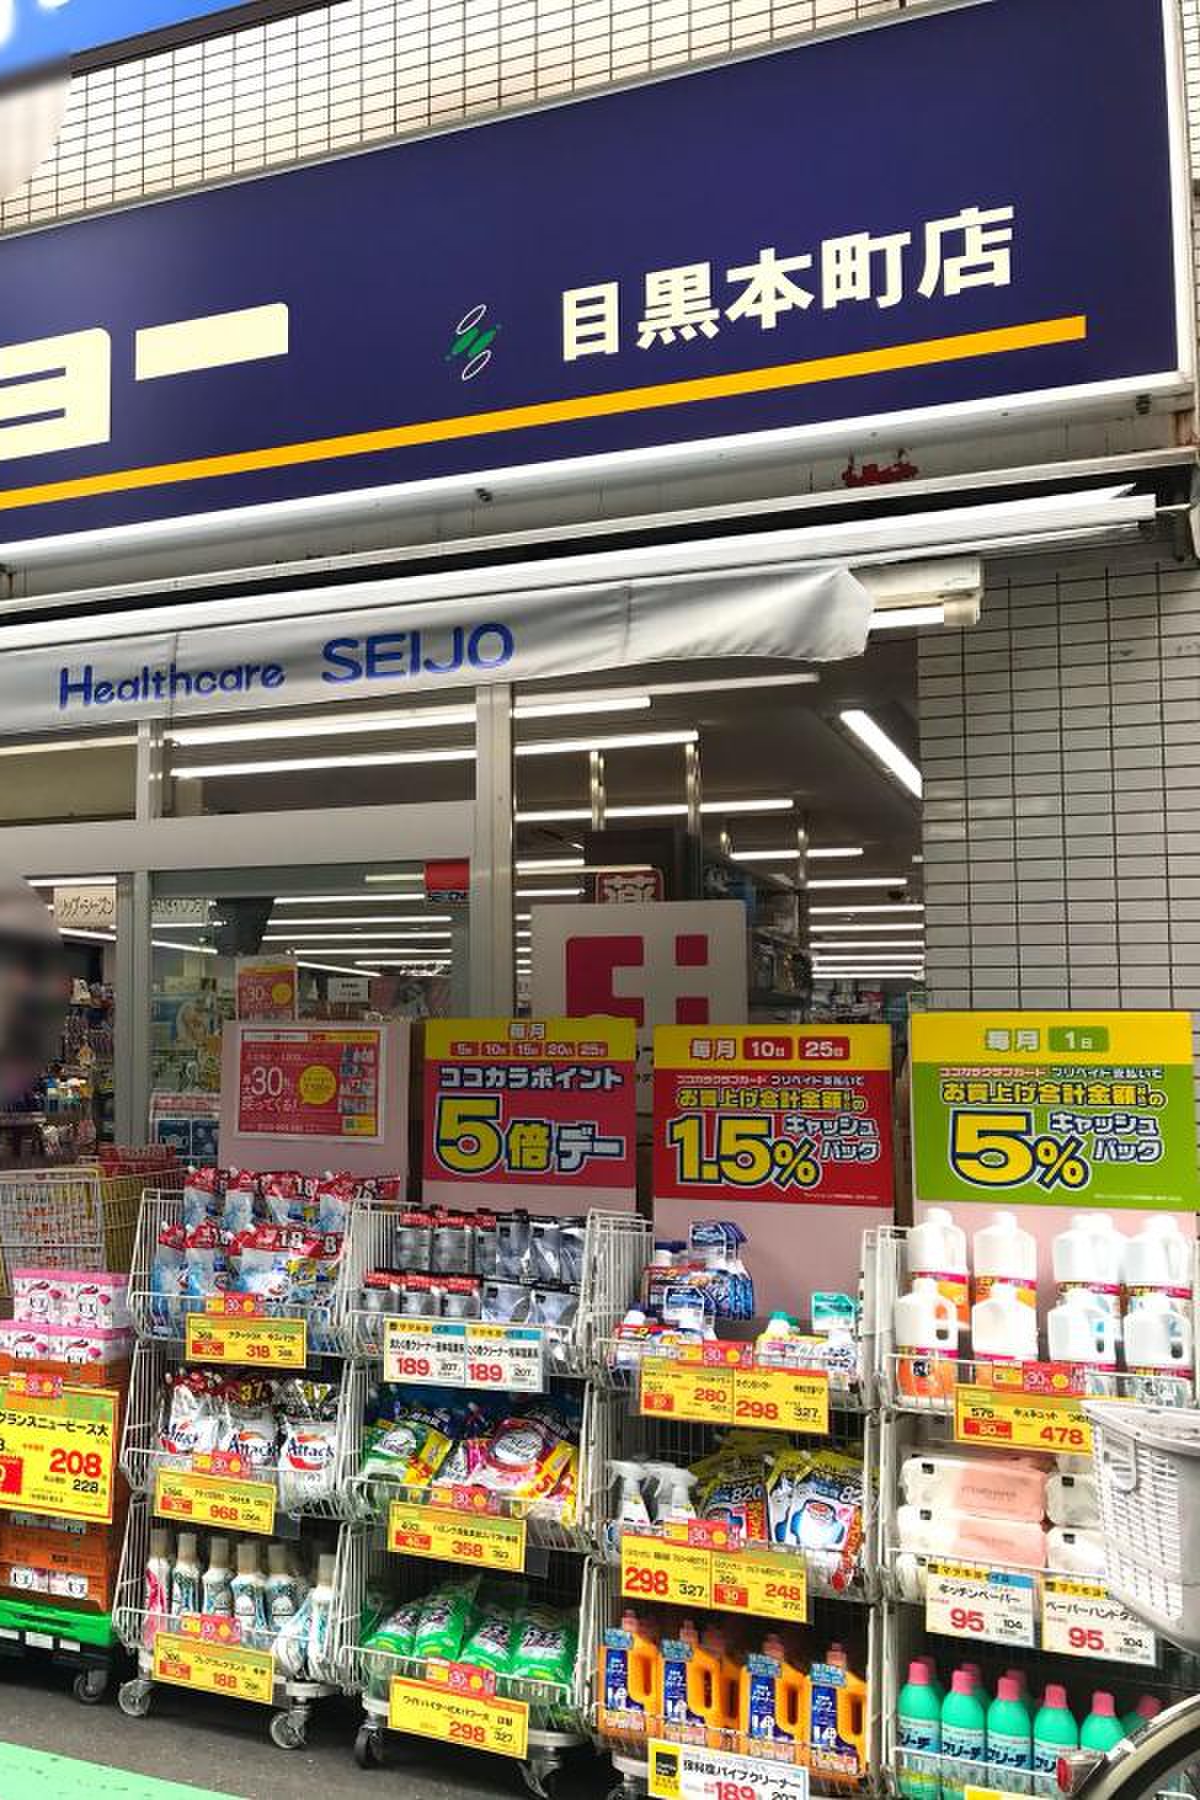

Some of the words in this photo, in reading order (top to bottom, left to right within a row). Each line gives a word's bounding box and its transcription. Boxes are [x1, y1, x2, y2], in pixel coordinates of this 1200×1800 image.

[561, 206, 1014, 362] 目黒本町店
[58, 661, 287, 709] Healthcare
[320, 622, 515, 684] SEIJO
[691, 1040, 736, 1060] 毎月
[986, 1029, 1040, 1051] 毎月
[1063, 1031, 1093, 1050] 1日
[440, 1066, 623, 1089] ココカラポイント
[435, 1093, 625, 1174] 5倍デー
[784, 1115, 878, 1137] キャッシュ
[1050, 1112, 1160, 1136] キャッシュ
[668, 1114, 821, 1191] 1.5%
[821, 1140, 879, 1161] バック
[950, 1109, 1090, 1190] 5%
[1093, 1139, 1162, 1162] バック
[245, 1344, 271, 1358] 318
[397, 1358, 431, 1376] 189
[467, 1363, 503, 1381] 189
[694, 1387, 727, 1403] 280
[736, 1400, 779, 1420] 298
[1040, 1426, 1084, 1444] 478
[287, 1436, 335, 1459] Attack
[50, 1448, 103, 1478] 208
[72, 1479, 100, 1494] 228
[731, 1482, 763, 1503] 820
[209, 1505, 239, 1521] 968
[451, 1540, 483, 1558] 358
[624, 1566, 669, 1596] 298
[679, 1583, 705, 1597] 327
[765, 1583, 802, 1601] 248
[939, 1584, 1021, 1603] キッチンペーパー
[950, 1608, 985, 1632] 95
[1069, 1627, 1105, 1650] 95
[213, 1672, 237, 1689] 188
[449, 1721, 486, 1744] 298
